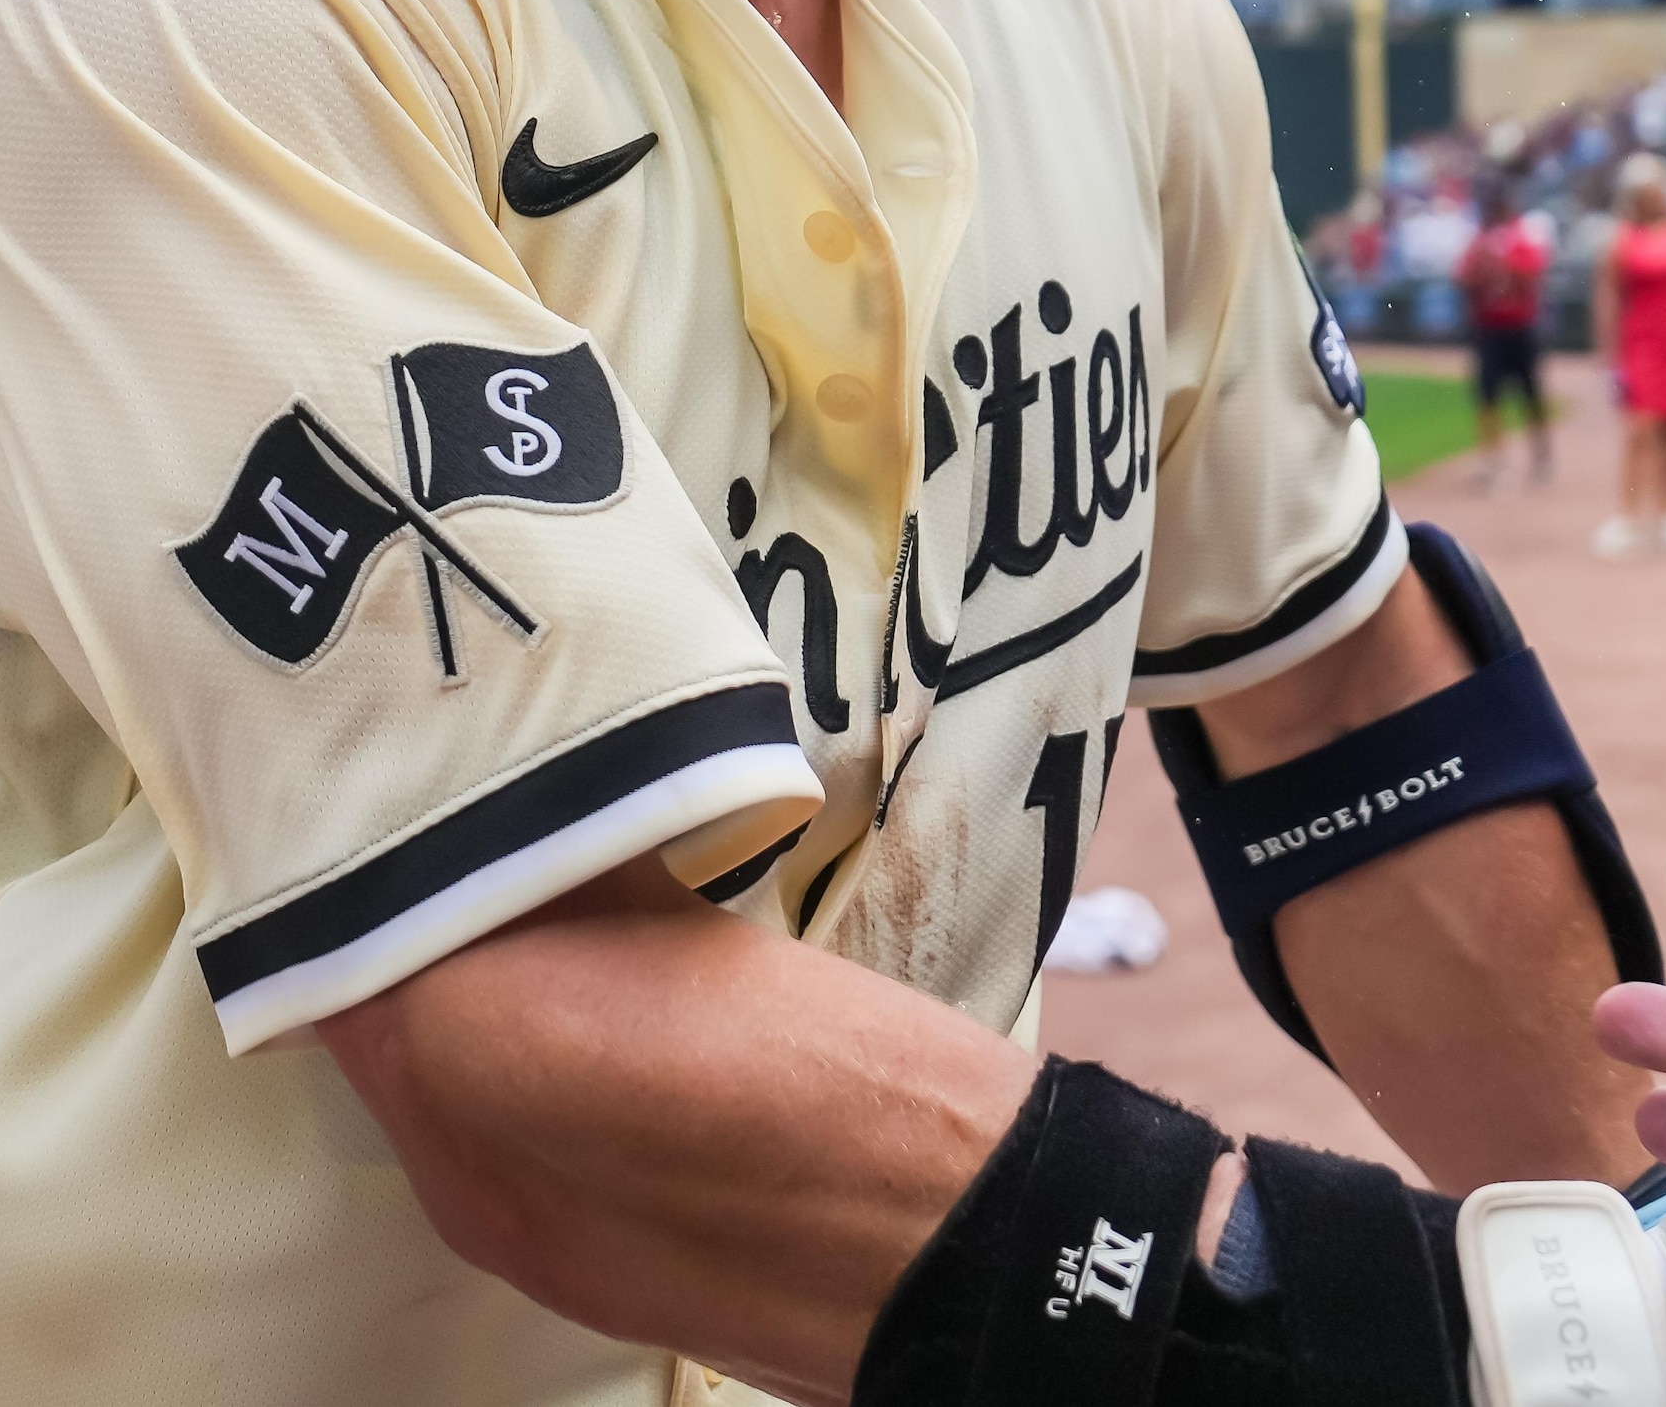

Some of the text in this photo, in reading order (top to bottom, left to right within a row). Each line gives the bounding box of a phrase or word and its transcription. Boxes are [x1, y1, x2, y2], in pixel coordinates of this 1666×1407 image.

[224, 476, 349, 615] M
[1024, 713, 1125, 984] 1
[1243, 756, 1465, 867] BRUCE BOLT
[1533, 1234, 1597, 1375] BRUCE
